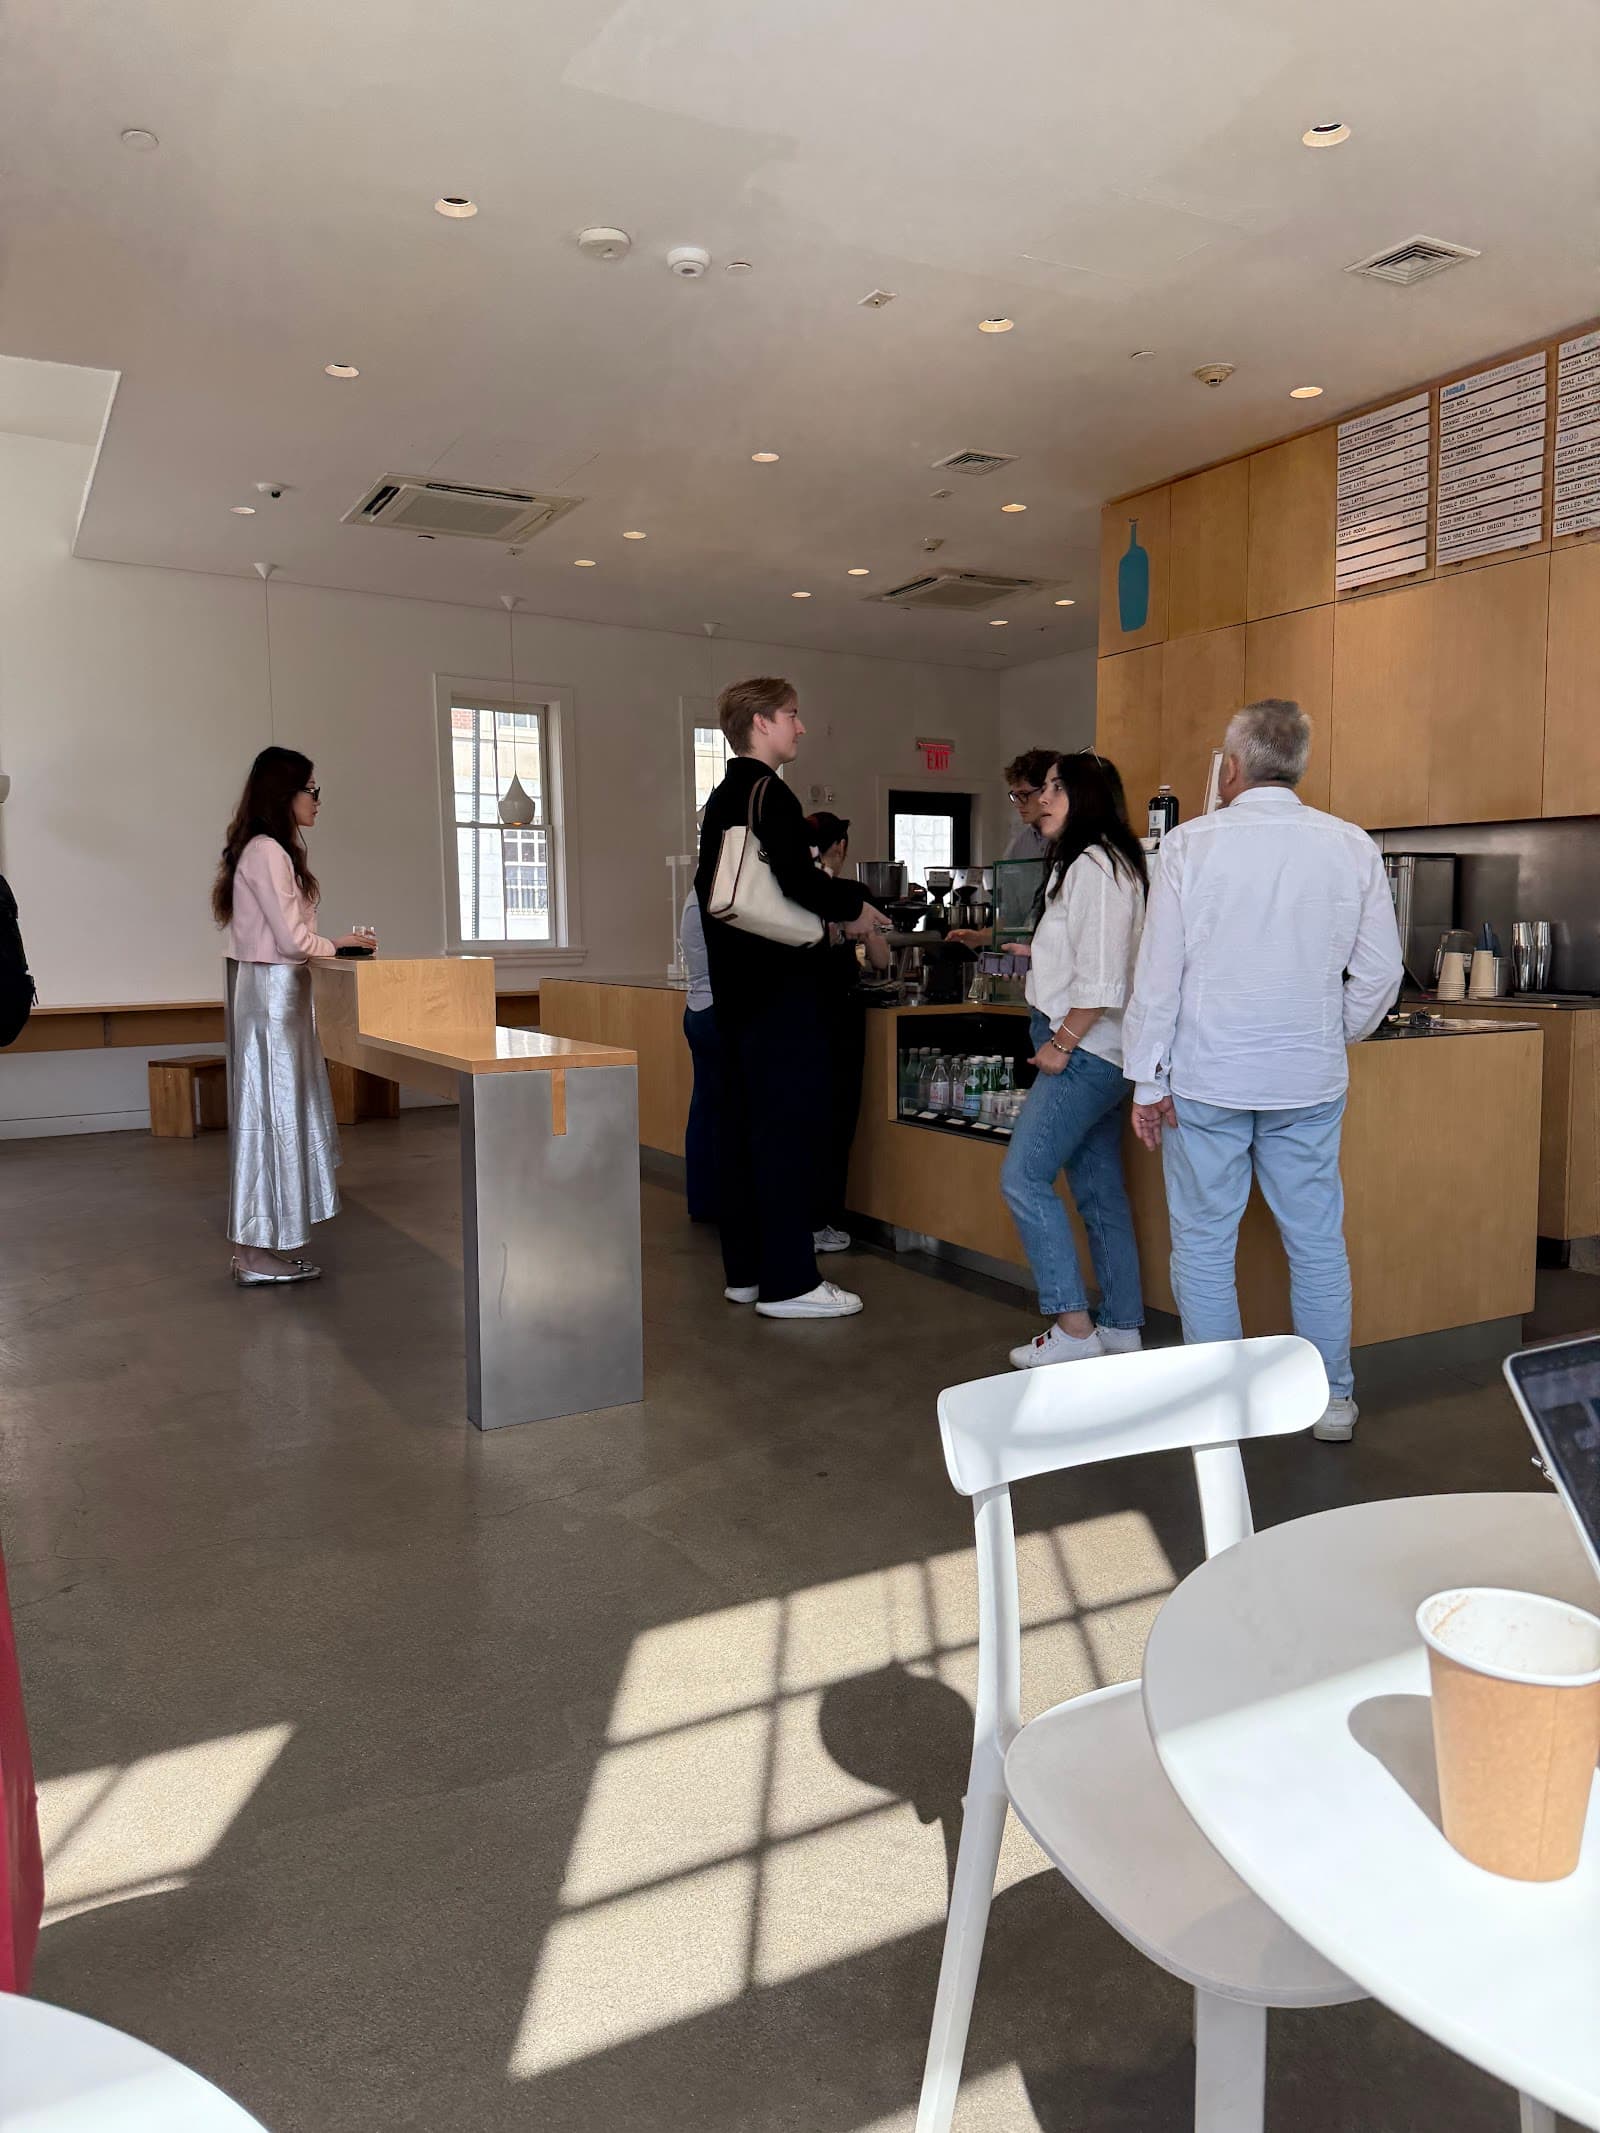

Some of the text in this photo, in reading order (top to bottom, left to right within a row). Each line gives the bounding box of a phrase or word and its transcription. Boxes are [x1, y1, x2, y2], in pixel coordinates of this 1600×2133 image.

[1562, 344, 1576, 353] TEA
[1561, 378, 1574, 387] CHAI
[1559, 432, 1578, 443] FOOD
[927, 749, 950, 770] EXIT
